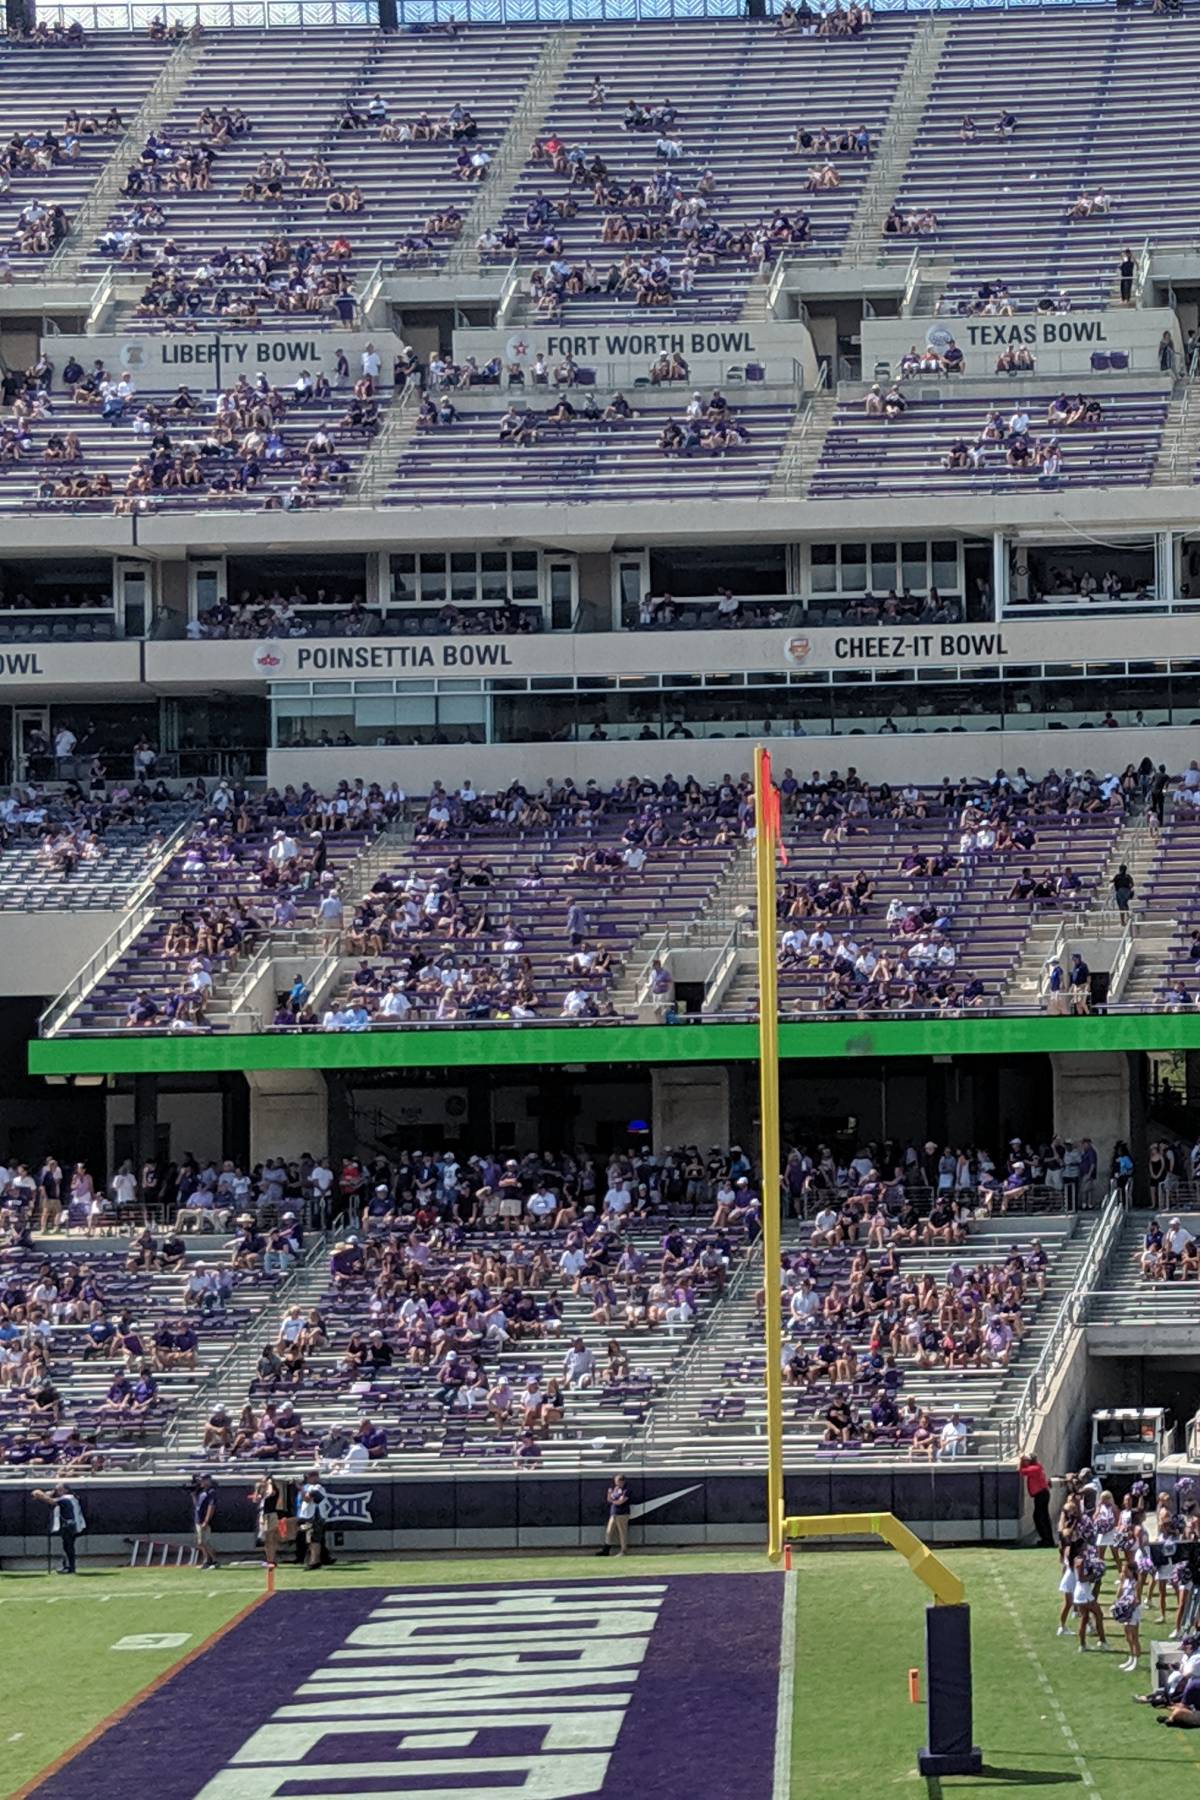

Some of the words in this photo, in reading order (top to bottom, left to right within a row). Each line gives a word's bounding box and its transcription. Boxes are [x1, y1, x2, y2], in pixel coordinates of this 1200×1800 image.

[547, 335, 601, 355] FORT
[607, 334, 684, 354] WORTH
[691, 332, 756, 353] BOWL
[967, 324, 1036, 345] TEXAS
[1043, 322, 1107, 343] BOWL
[162, 342, 248, 364] LIBERTY
[257, 342, 321, 362] BOWL
[298, 645, 433, 669] POINSETTIA
[443, 644, 512, 666] BOWL
[835, 635, 933, 659] CHEEZ-IT
[941, 634, 1007, 656] BOWL
[299, 1034, 404, 1065] RAM
[608, 1027, 709, 1057] ZOO
[1076, 1016, 1181, 1047] RAM
[328, 1497, 367, 1518] XII
[194, 1584, 669, 1800] HORNED
